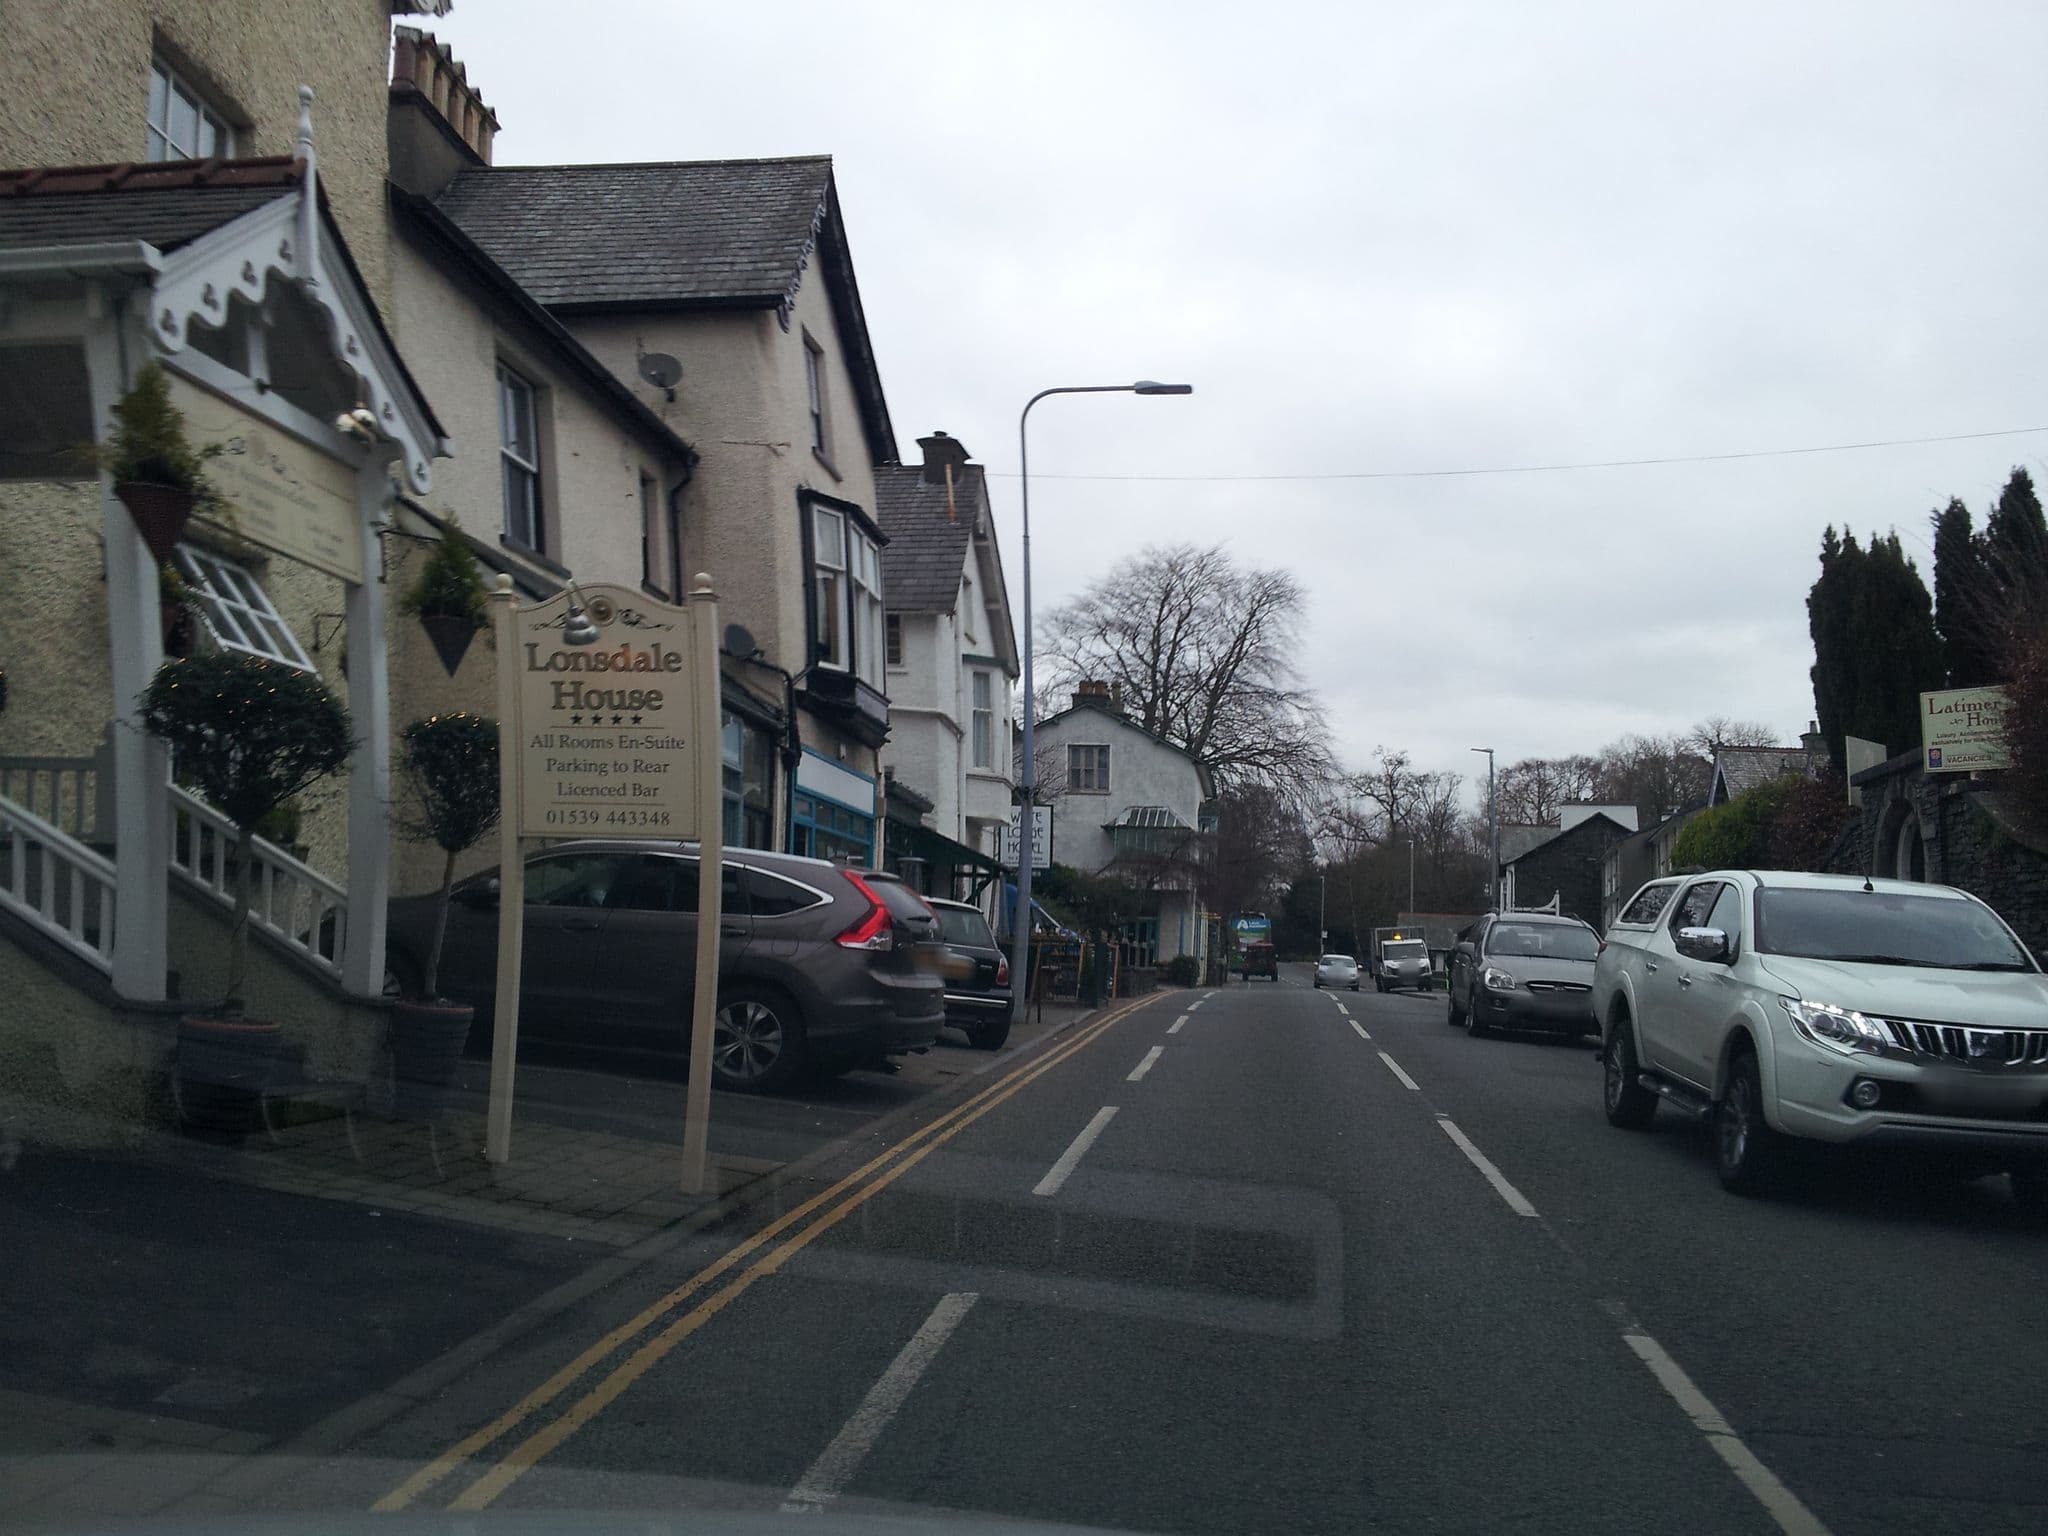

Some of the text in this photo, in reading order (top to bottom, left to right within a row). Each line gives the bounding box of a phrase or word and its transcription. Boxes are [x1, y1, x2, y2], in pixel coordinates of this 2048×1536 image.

[524, 642, 682, 673] Lonsdale
[551, 680, 663, 711] House
[1928, 698, 2000, 715] Latimer
[530, 734, 685, 750] All Rooms En-Suite
[546, 759, 670, 776] Parking to Rear
[557, 783, 659, 797] Licenced Bar
[546, 810, 671, 826] 01539 443348
